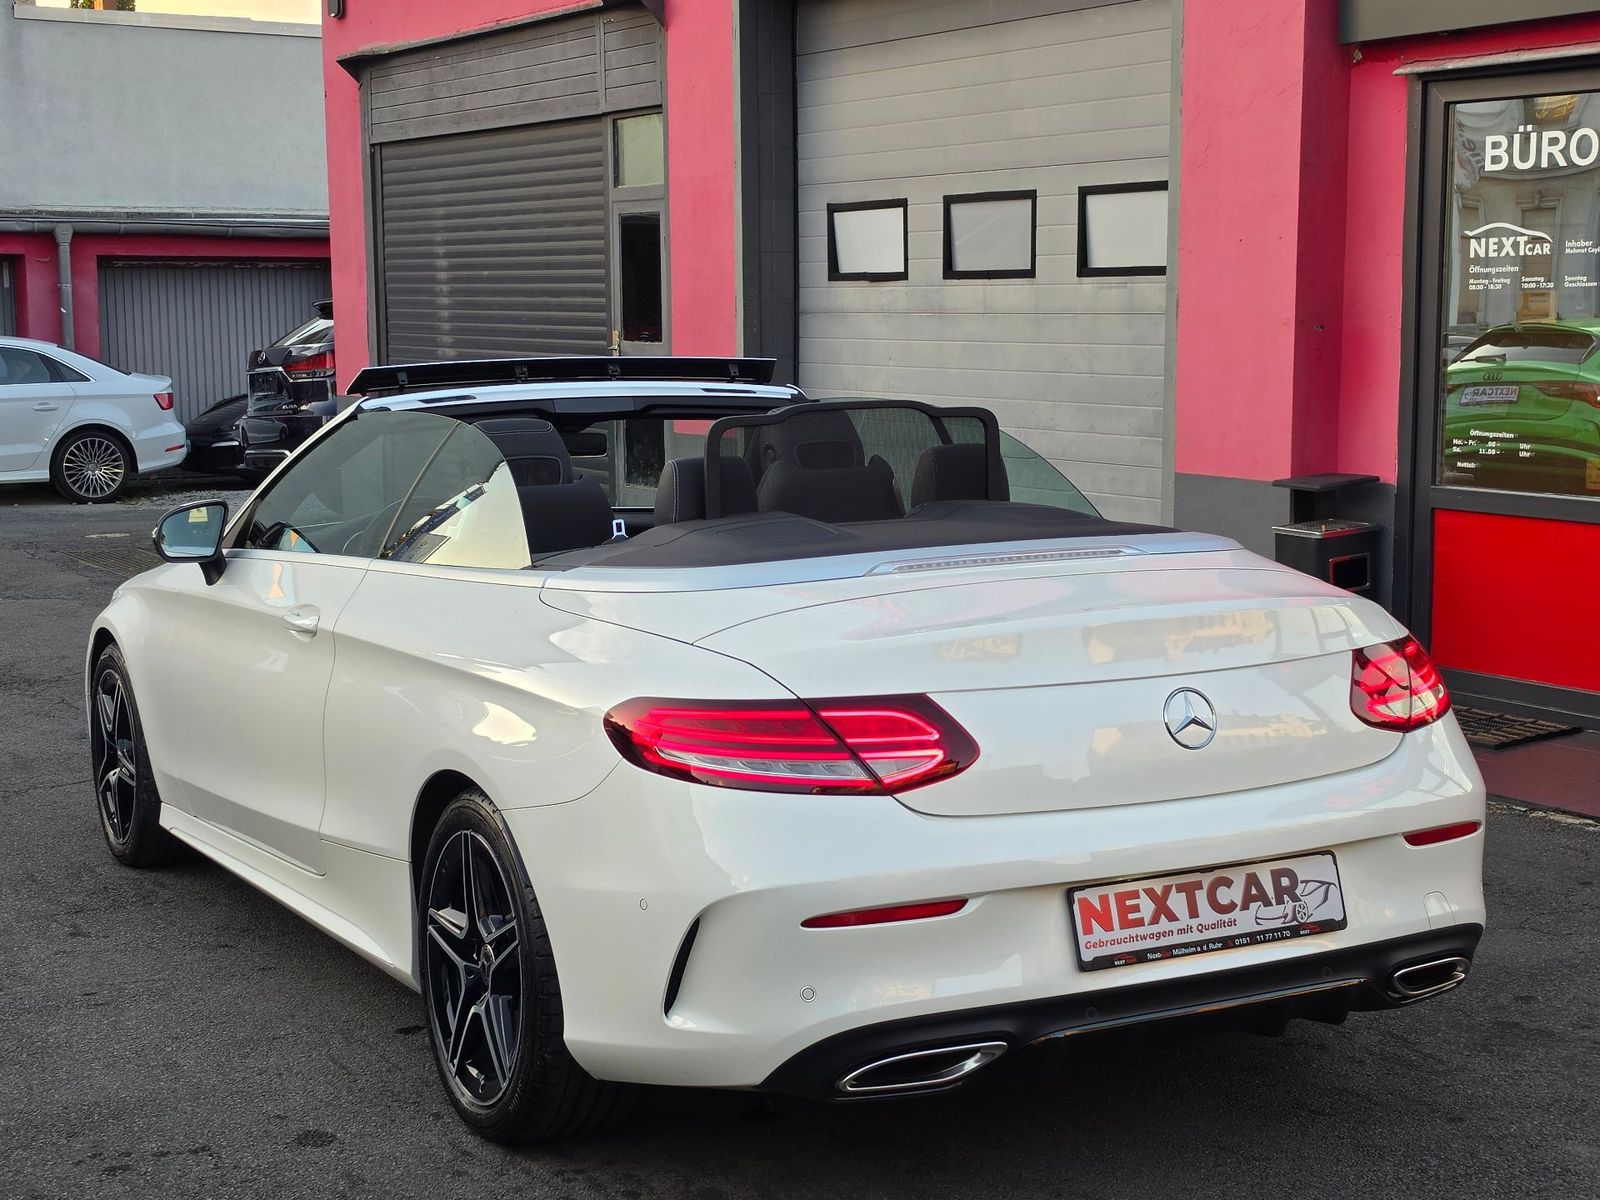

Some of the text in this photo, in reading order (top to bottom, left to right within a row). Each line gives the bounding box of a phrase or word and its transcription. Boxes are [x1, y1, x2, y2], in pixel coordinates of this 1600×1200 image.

[1484, 124, 1599, 172] BÜRO
[1565, 239, 1593, 248] Inhaber
[1469, 265, 1519, 274] Öffnungszeiten
[1564, 280, 1597, 288] Geschlossen
[1469, 429, 1515, 438] Öffnungszeiten
[1077, 867, 1302, 936] NEXTCAR
[1084, 917, 1238, 950] Gebrauchtwagen mit Qualität
[1235, 937, 1250, 946] 0151
[1274, 931, 1281, 939] 11
